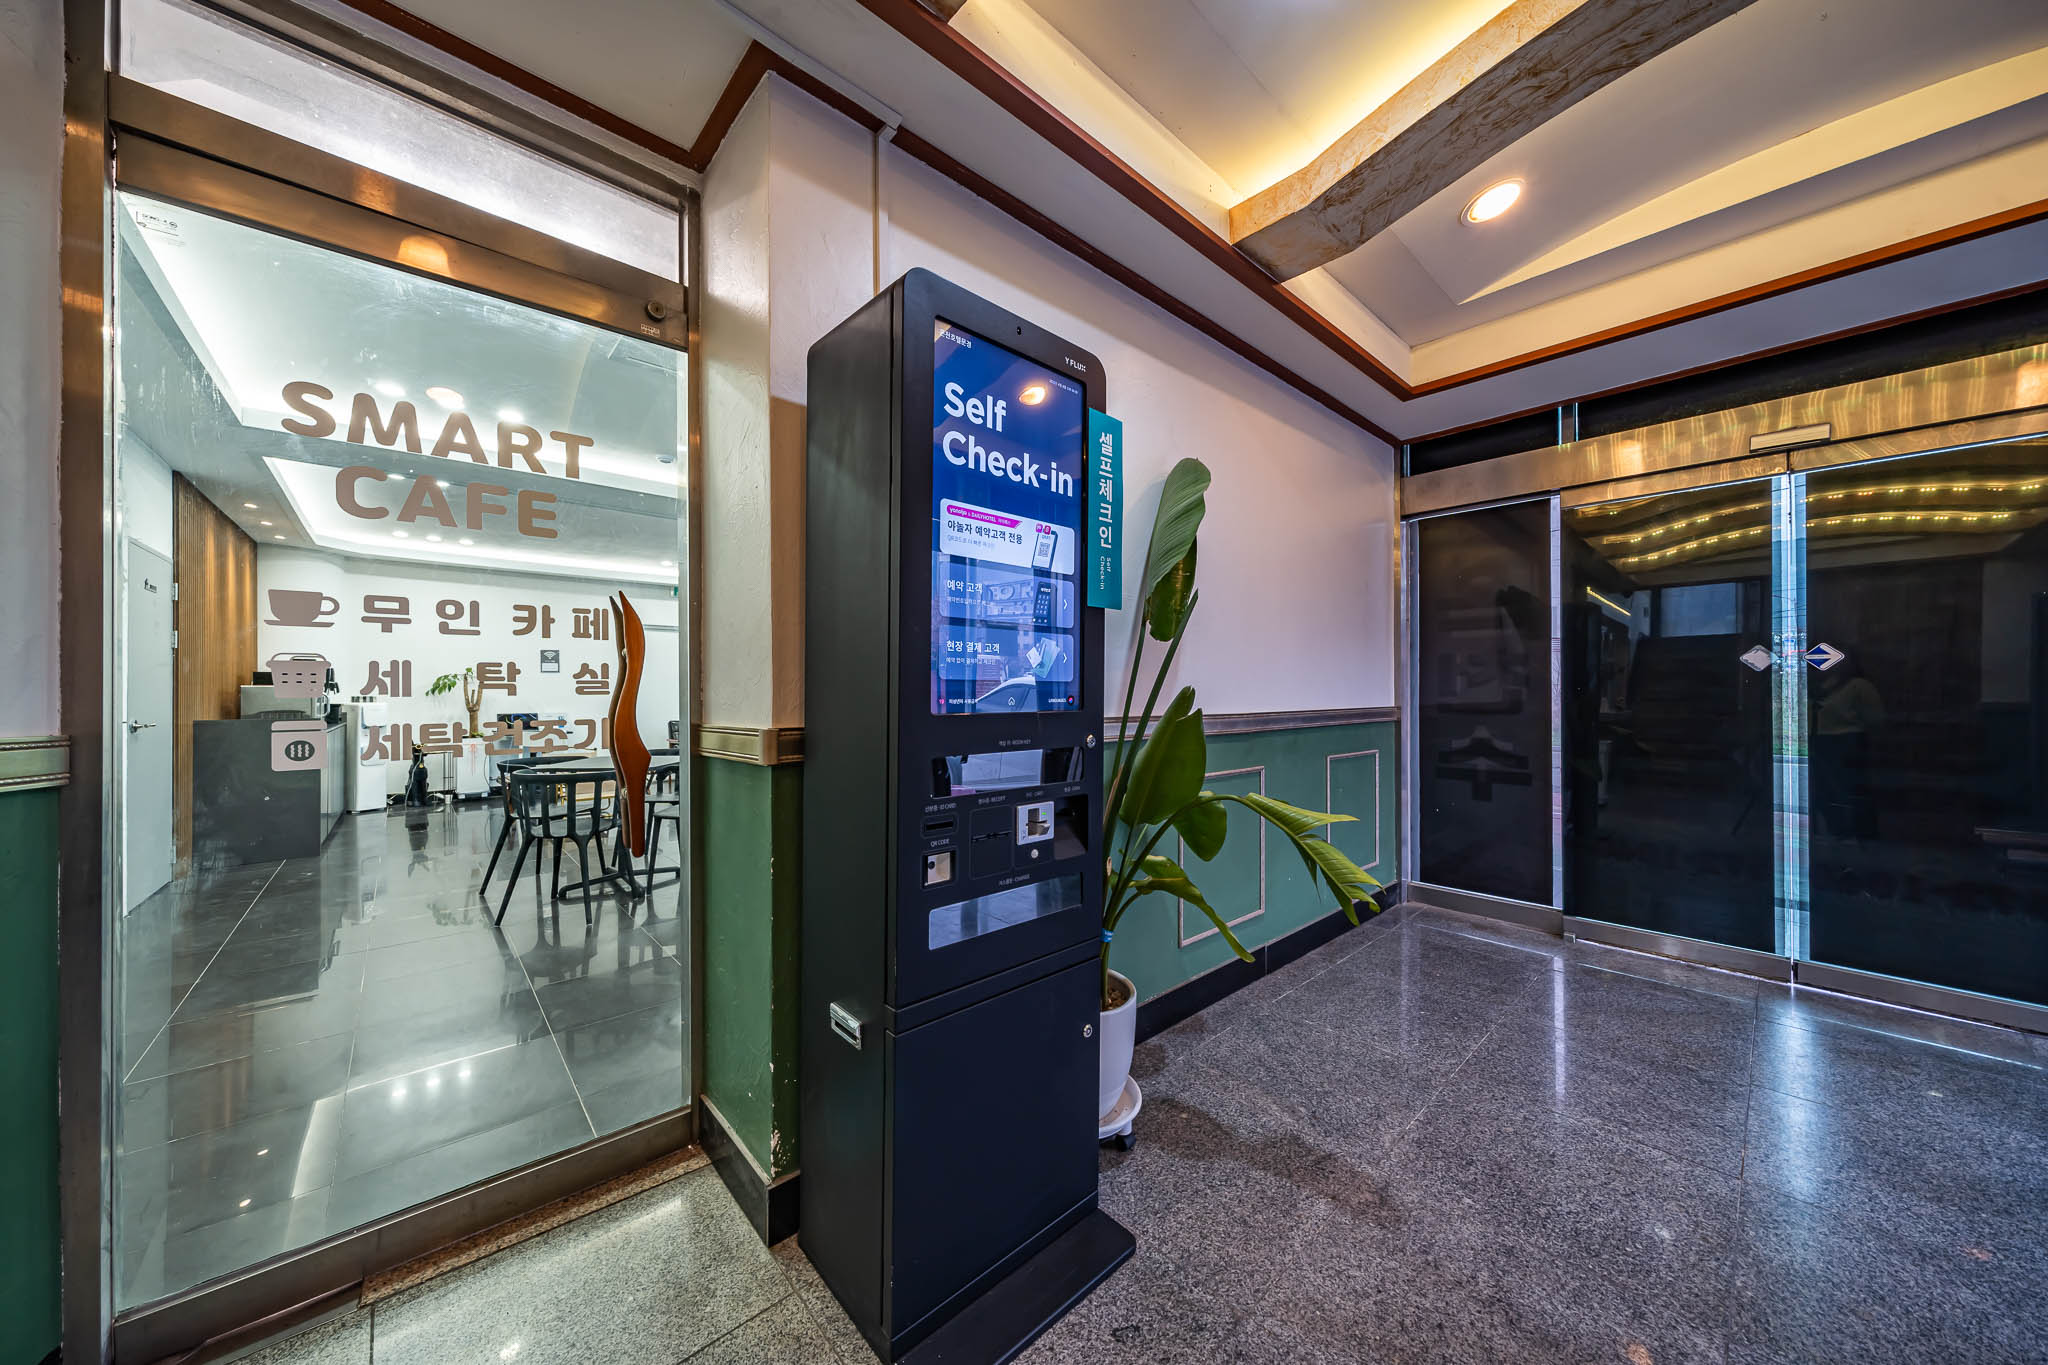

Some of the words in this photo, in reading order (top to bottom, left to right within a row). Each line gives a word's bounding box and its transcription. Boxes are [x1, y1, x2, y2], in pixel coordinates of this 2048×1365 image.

[281, 381, 595, 480] SMART
[943, 381, 1007, 433] Self
[942, 430, 1073, 497] Check-in
[1098, 431, 1113, 549] 셀프체크인
[335, 466, 559, 540] CAFE
[947, 520, 972, 535] 야놀자
[1008, 533, 1023, 545] 전용
[947, 579, 964, 592] 예약
[966, 582, 983, 593] 고객
[946, 640, 963, 652] 현장
[966, 641, 982, 653] 결제
[984, 643, 1000, 654] 고객
